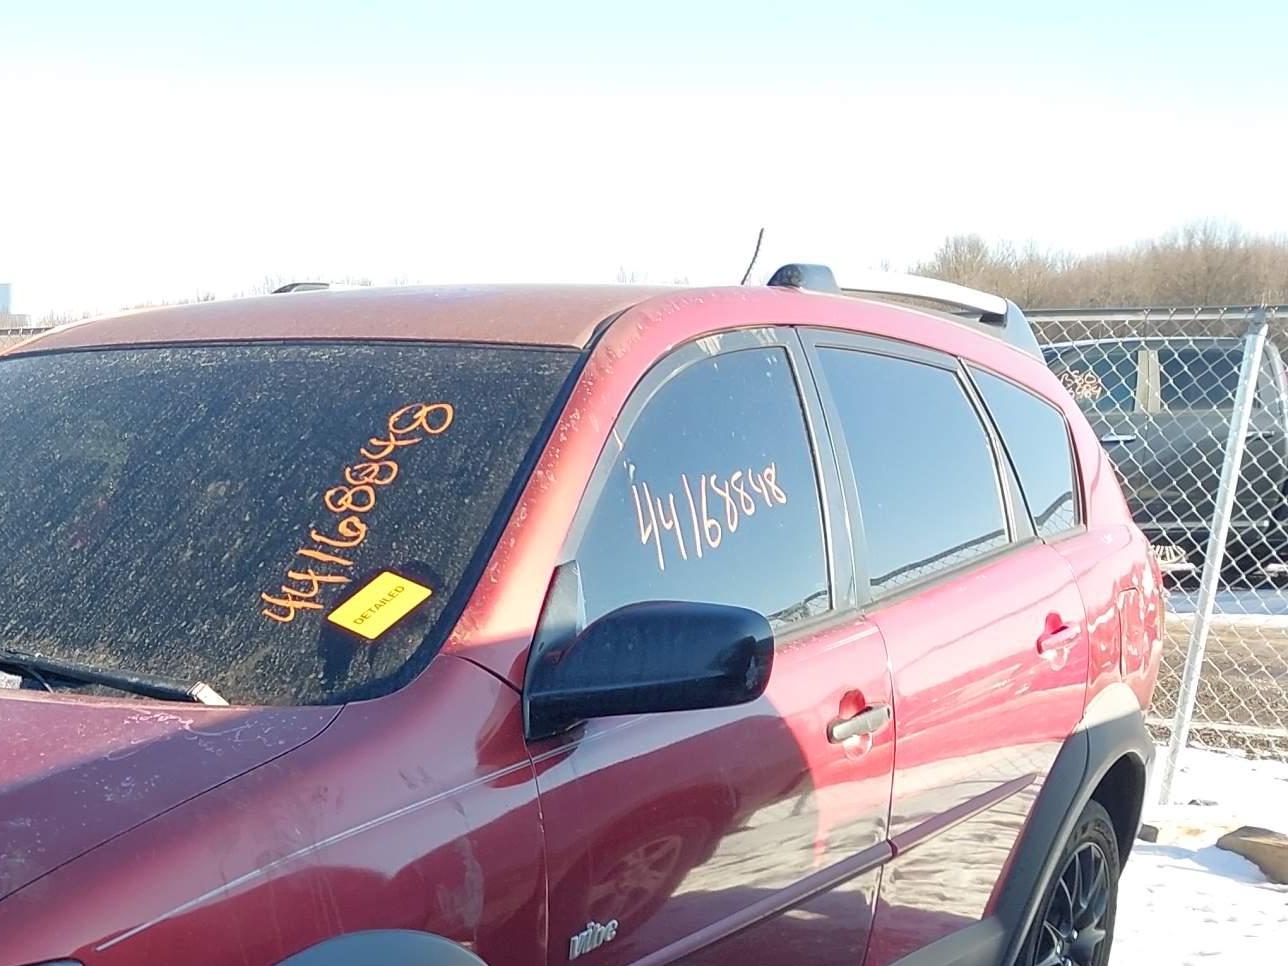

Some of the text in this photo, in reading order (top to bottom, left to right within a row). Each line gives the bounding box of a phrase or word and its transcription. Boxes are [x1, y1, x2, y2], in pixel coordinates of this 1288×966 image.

[261, 403, 454, 622] 44168848
[632, 462, 787, 571] 44168848
[353, 585, 405, 625] DETAILED
